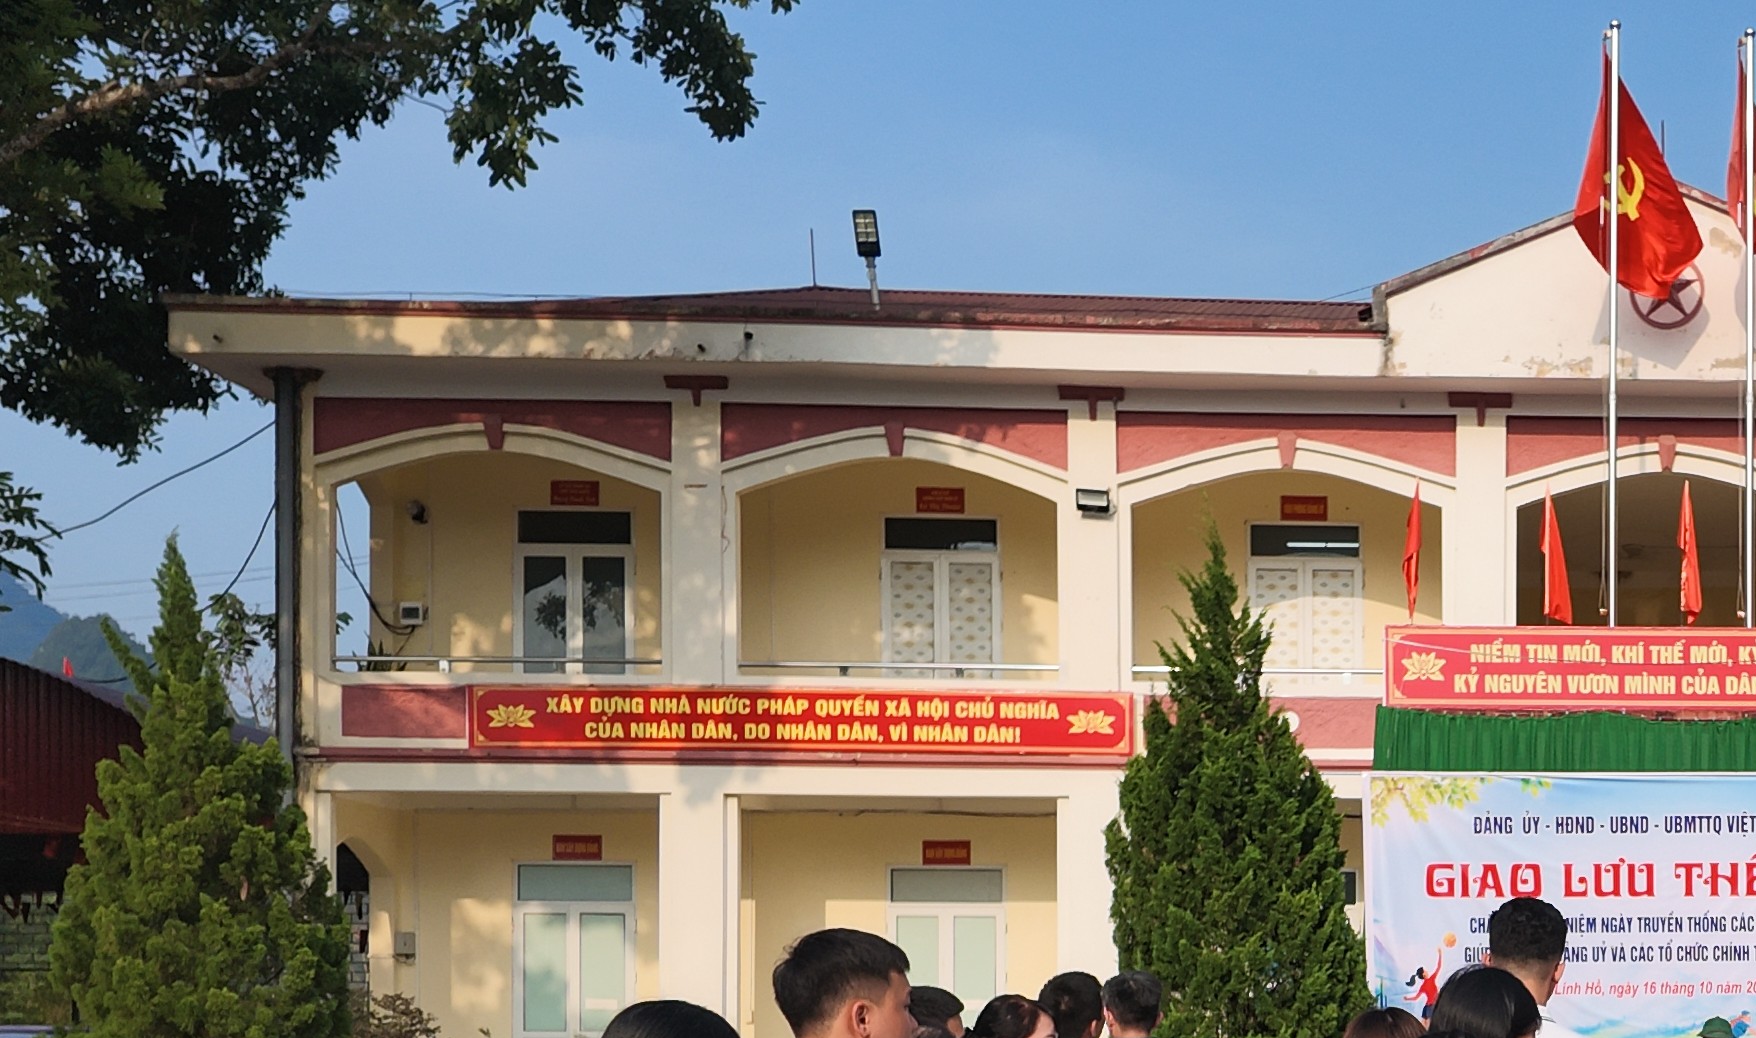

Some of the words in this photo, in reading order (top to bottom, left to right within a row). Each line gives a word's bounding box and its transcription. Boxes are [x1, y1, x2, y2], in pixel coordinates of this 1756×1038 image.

[1526, 644, 1558, 664] TIN
[1563, 638, 1607, 667] MỚI,
[1612, 641, 1645, 664] KHÍ
[1649, 638, 1685, 665] THẾ
[1690, 640, 1733, 667] MỚI,
[1454, 666, 1479, 693] KỶ
[1484, 671, 1562, 694] NGUYÊN
[1567, 674, 1619, 694] VƯƠN
[1624, 671, 1676, 695] MÌNH
[1681, 668, 1720, 695] CỦA
[546, 694, 584, 714] XÂY
[590, 695, 643, 717] DỰNG
[650, 694, 691, 714] NHÀ
[697, 694, 751, 715] NƯỚC
[756, 695, 809, 717] PHÁP
[885, 697, 911, 717] XÃ
[917, 698, 949, 721] HỘI
[955, 696, 995, 719] CHỦ
[1000, 699, 1060, 720] NGHĨA
[584, 715, 624, 739] CỦA
[630, 719, 685, 739] NHÂN
[692, 720, 738, 741] DÂN,
[745, 722, 771, 740] DO
[777, 720, 831, 741] NHÂN
[837, 721, 884, 743] DÂN,
[889, 722, 908, 742] VÌ
[913, 722, 969, 743] NHÂN
[974, 722, 1021, 744] DÂN!
[1473, 811, 1513, 834] ĐẢNG
[1522, 811, 1540, 834] ỦY
[1556, 816, 1595, 834] HĐND
[1610, 816, 1649, 834] UBND
[1664, 815, 1722, 835] UBMTTQ
[1726, 811, 1756, 837] VIỆT
[1426, 863, 1543, 898] GIAO
[1563, 857, 1655, 898] LƯU
[1567, 913, 1597, 937] NIỆM
[1601, 913, 1633, 933] NGÀY
[1687, 909, 1727, 932] THỐNG
[1731, 912, 1755, 932] CÁC
[1564, 941, 1588, 962] ẢNG
[1592, 940, 1607, 962] UỶ
[1611, 943, 1626, 962] VÀ
[1630, 943, 1654, 962] CÁC
[1677, 942, 1709, 962] CHỨC
[1713, 941, 1750, 962] CHÍNH
[1609, 982, 1639, 998] ngày
[1643, 982, 1657, 995] 16
[1660, 981, 1695, 998] tháng
[1699, 981, 1713, 994] 10
[1716, 981, 1742, 994] năm
